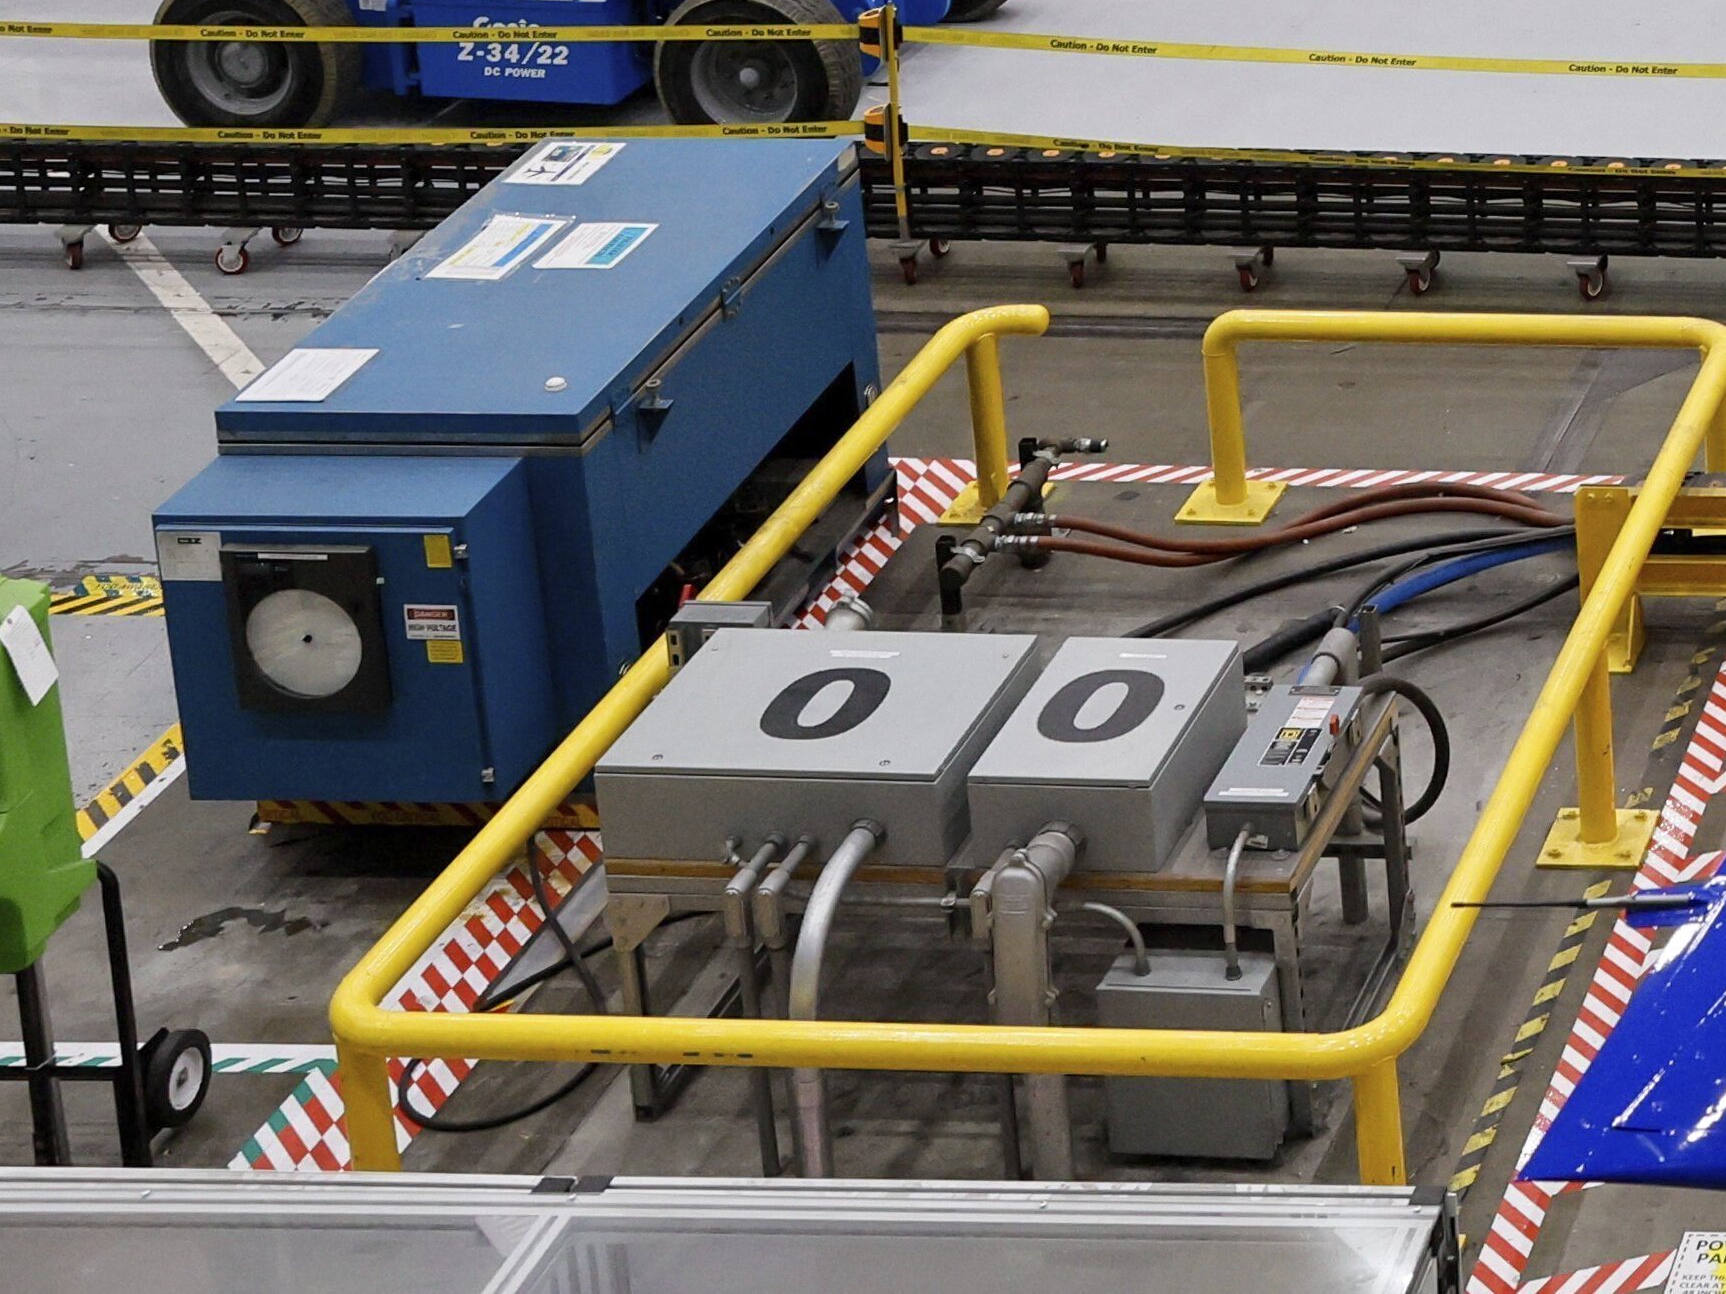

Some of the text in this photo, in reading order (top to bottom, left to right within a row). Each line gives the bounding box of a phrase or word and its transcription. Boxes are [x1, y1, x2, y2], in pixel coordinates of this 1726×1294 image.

[200, 28, 304, 40] Caution Do Not Enter
[452, 30, 558, 39] Caution Do Not Enter
[706, 28, 811, 37] Caution Do Not Enter
[1050, 39, 1157, 54] Caution Do Not Enter
[458, 42, 569, 66] Z-34/22
[1308, 53, 1416, 67] Caution Do Not Enter
[484, 67, 546, 78] DC POWER
[1569, 63, 1678, 75] Caution Do Not Enter
[43, 127, 70, 136] Enter
[470, 130, 504, 140] Caution
[515, 130, 528, 139] Do
[549, 130, 575, 138] Enter
[723, 124, 827, 136] Caution Do Not Enter
[217, 131, 322, 141] Caution Do Not Enter
